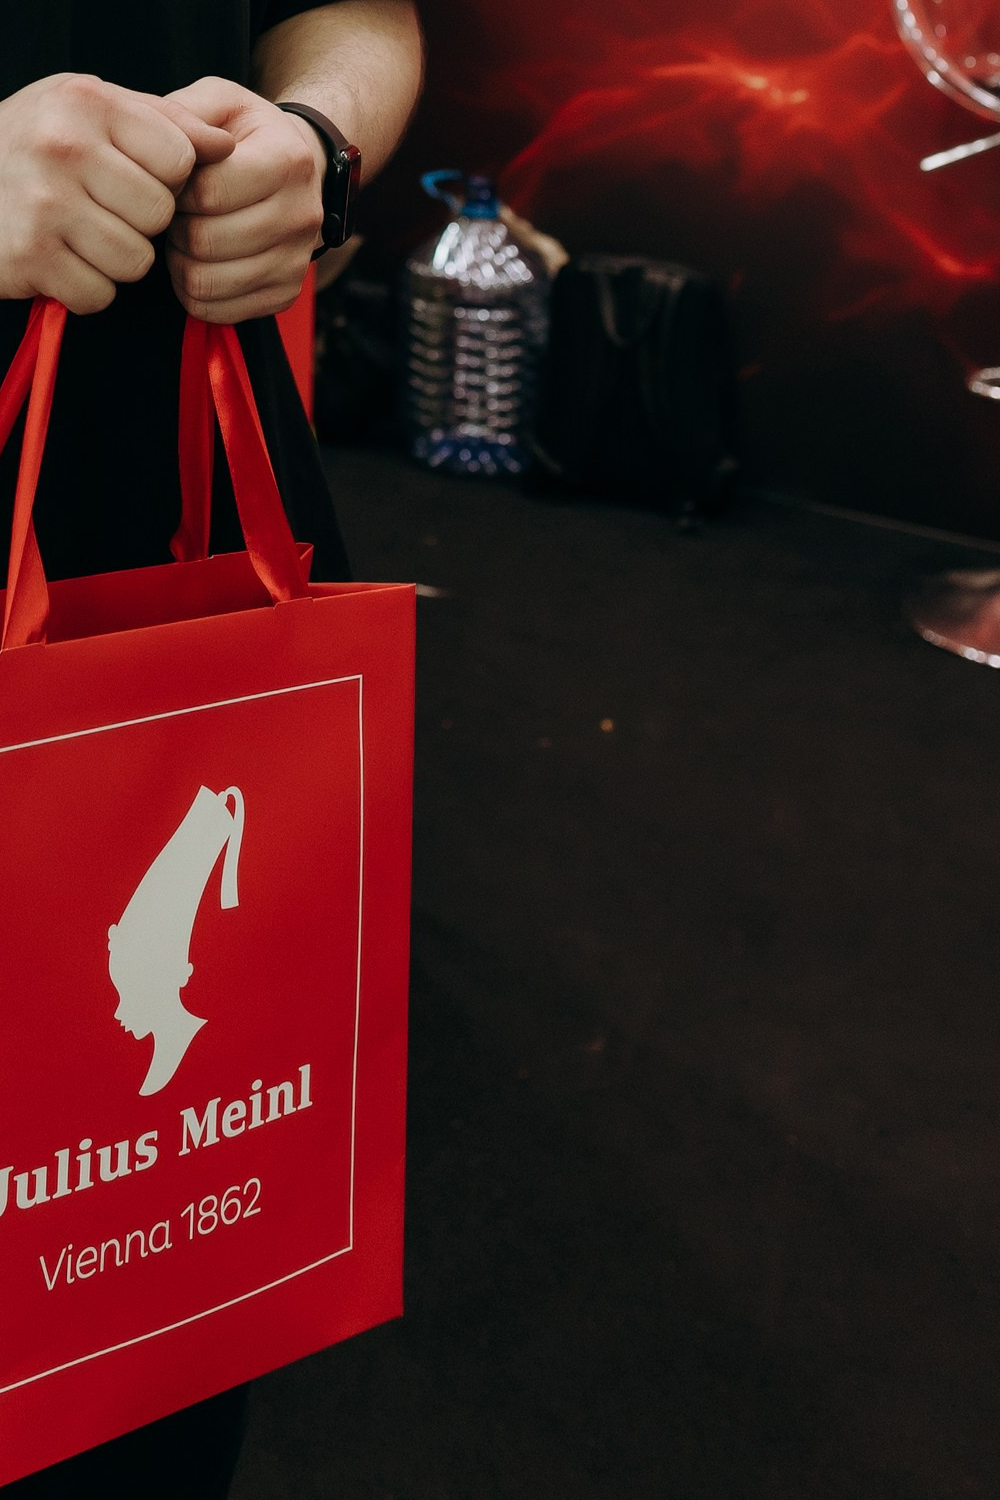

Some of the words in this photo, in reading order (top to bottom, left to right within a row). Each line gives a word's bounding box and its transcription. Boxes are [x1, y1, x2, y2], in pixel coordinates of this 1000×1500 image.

[178, 1063, 314, 1157] Meinl
[39, 1219, 173, 1291] Vienna
[180, 1177, 262, 1240] 1862
